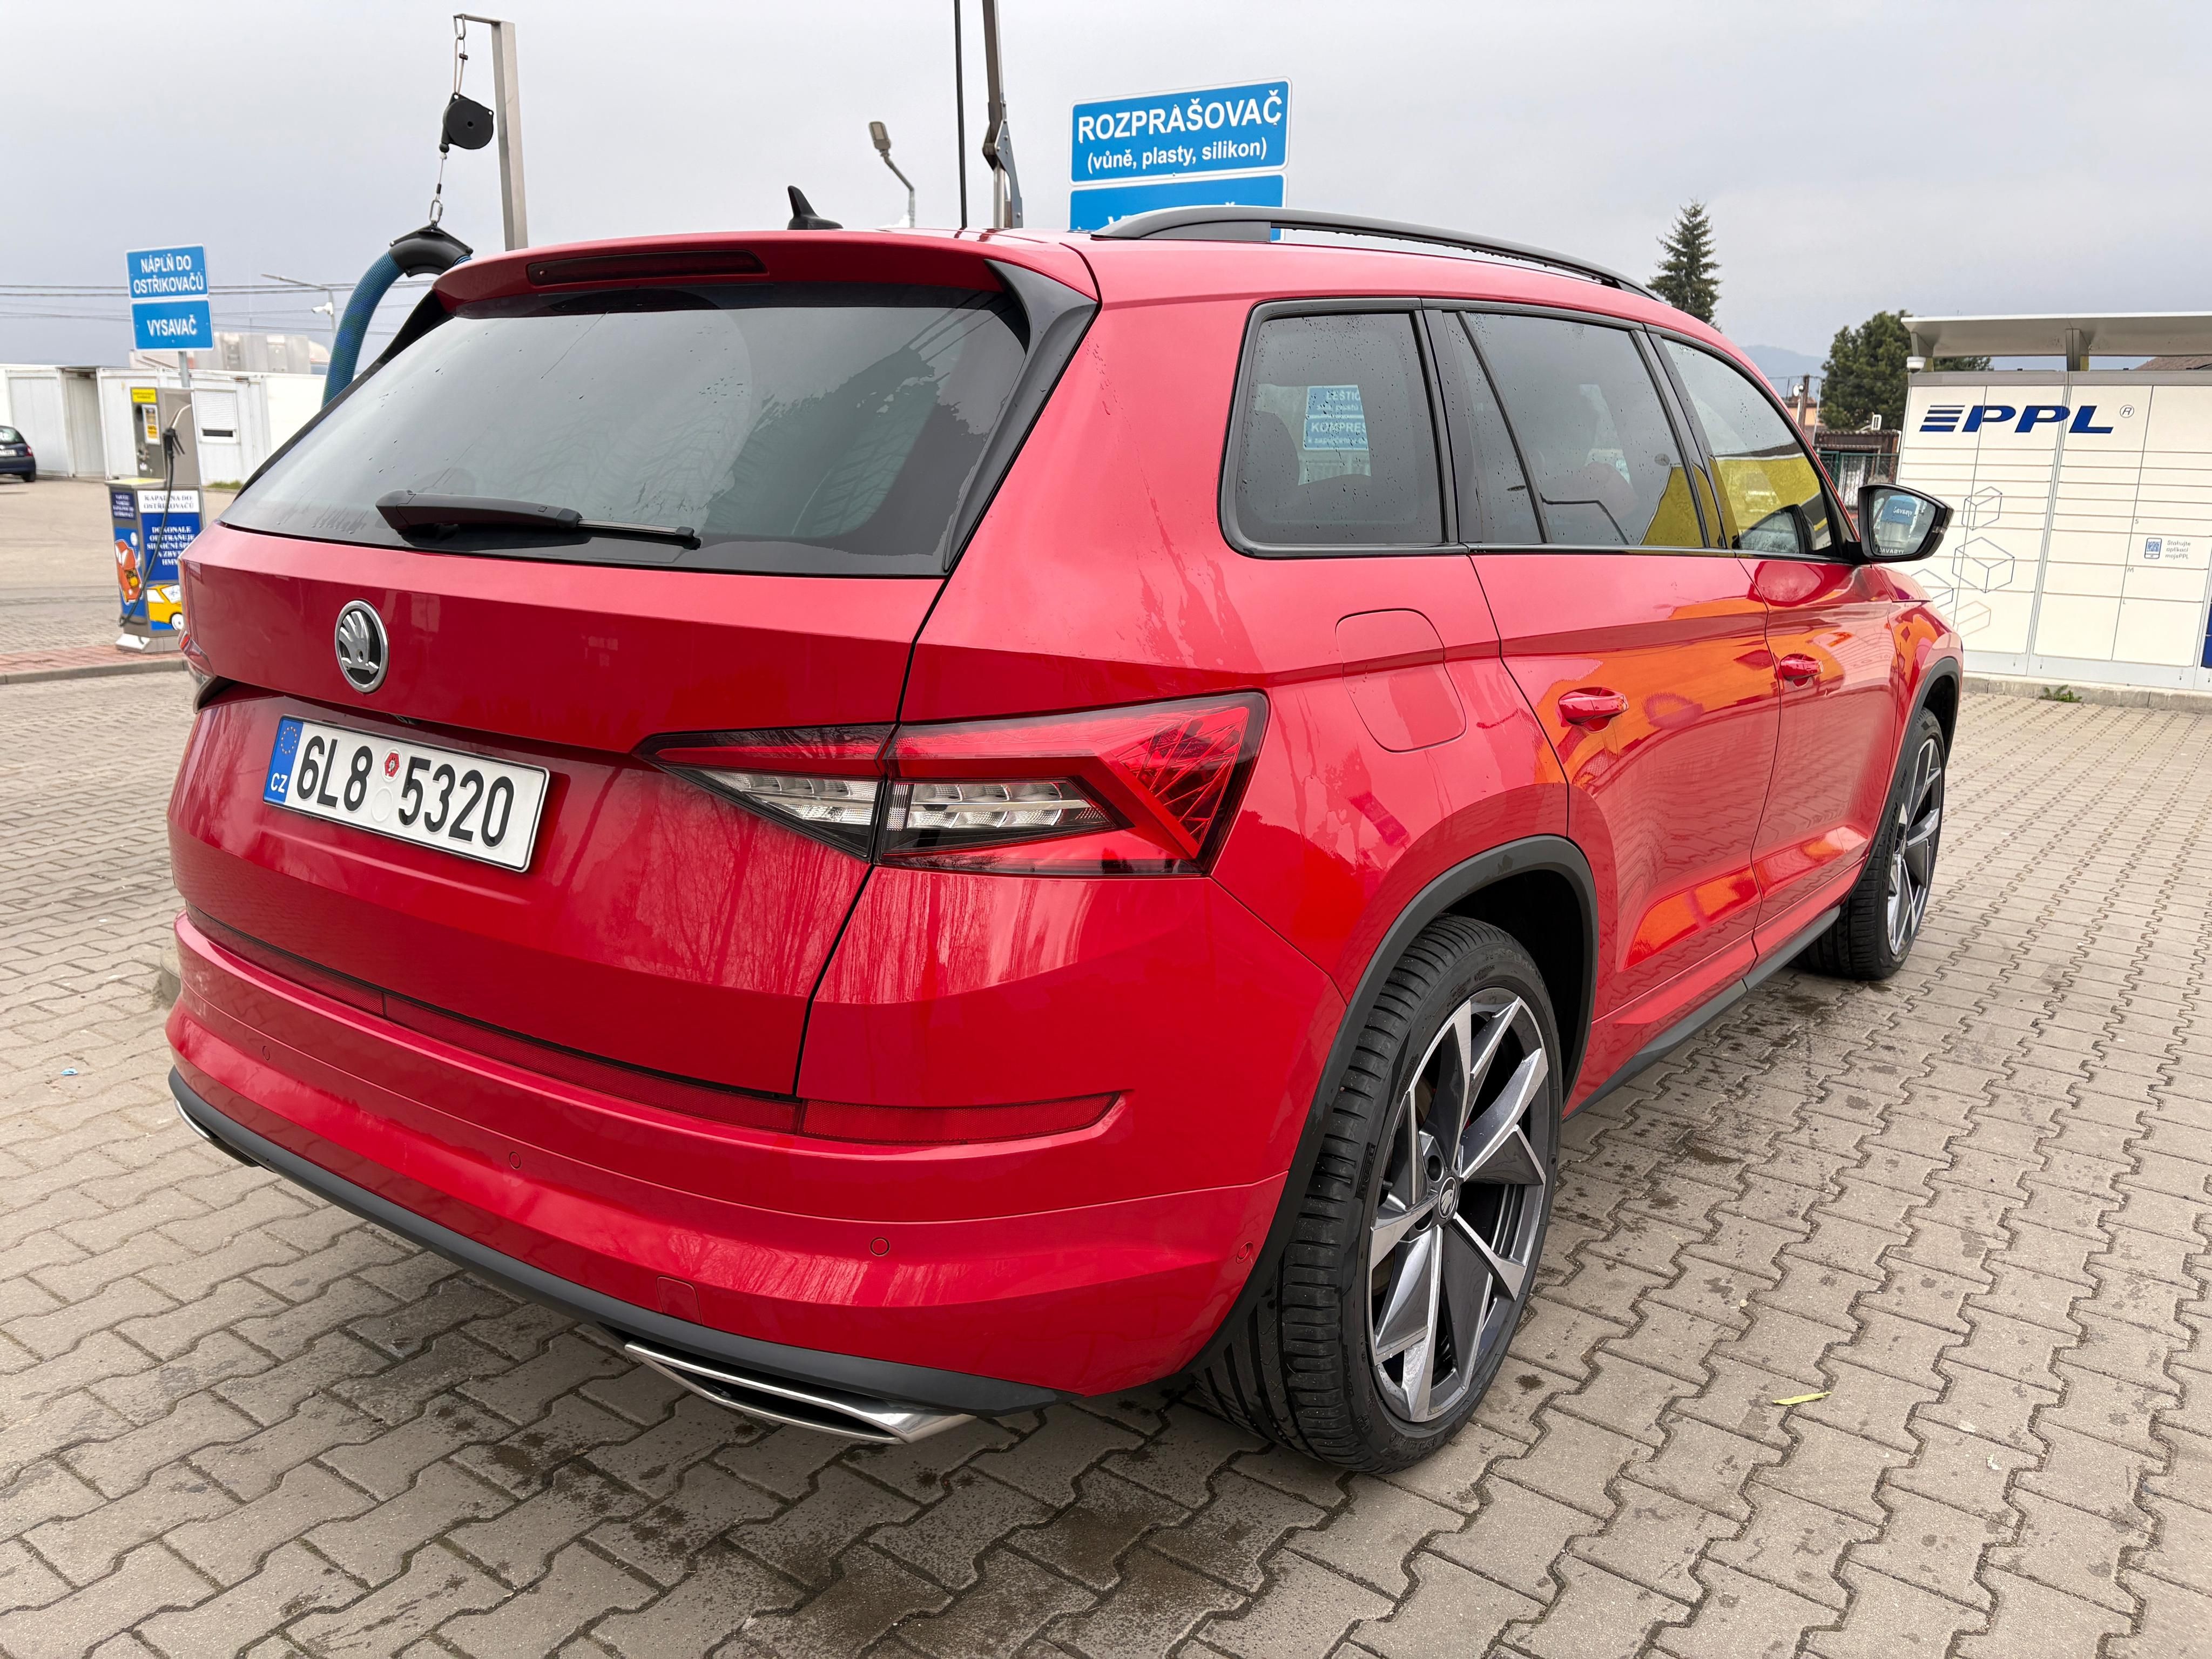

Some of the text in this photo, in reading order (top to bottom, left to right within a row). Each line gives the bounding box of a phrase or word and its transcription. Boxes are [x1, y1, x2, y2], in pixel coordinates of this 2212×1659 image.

[1078, 90, 1283, 141] ROZPRAŠOVAČ
[1088, 137, 1267, 174] (vůně, plasty, silikon)
[140, 253, 192, 273] NÁPLŇ DO
[133, 271, 204, 294] OSTŘIKOVAČŮ
[147, 314, 197, 336] VYSAVAČ
[1962, 405, 2114, 434] PPL
[271, 772, 288, 793] CZ
[296, 736, 514, 847] 6L8 5320
